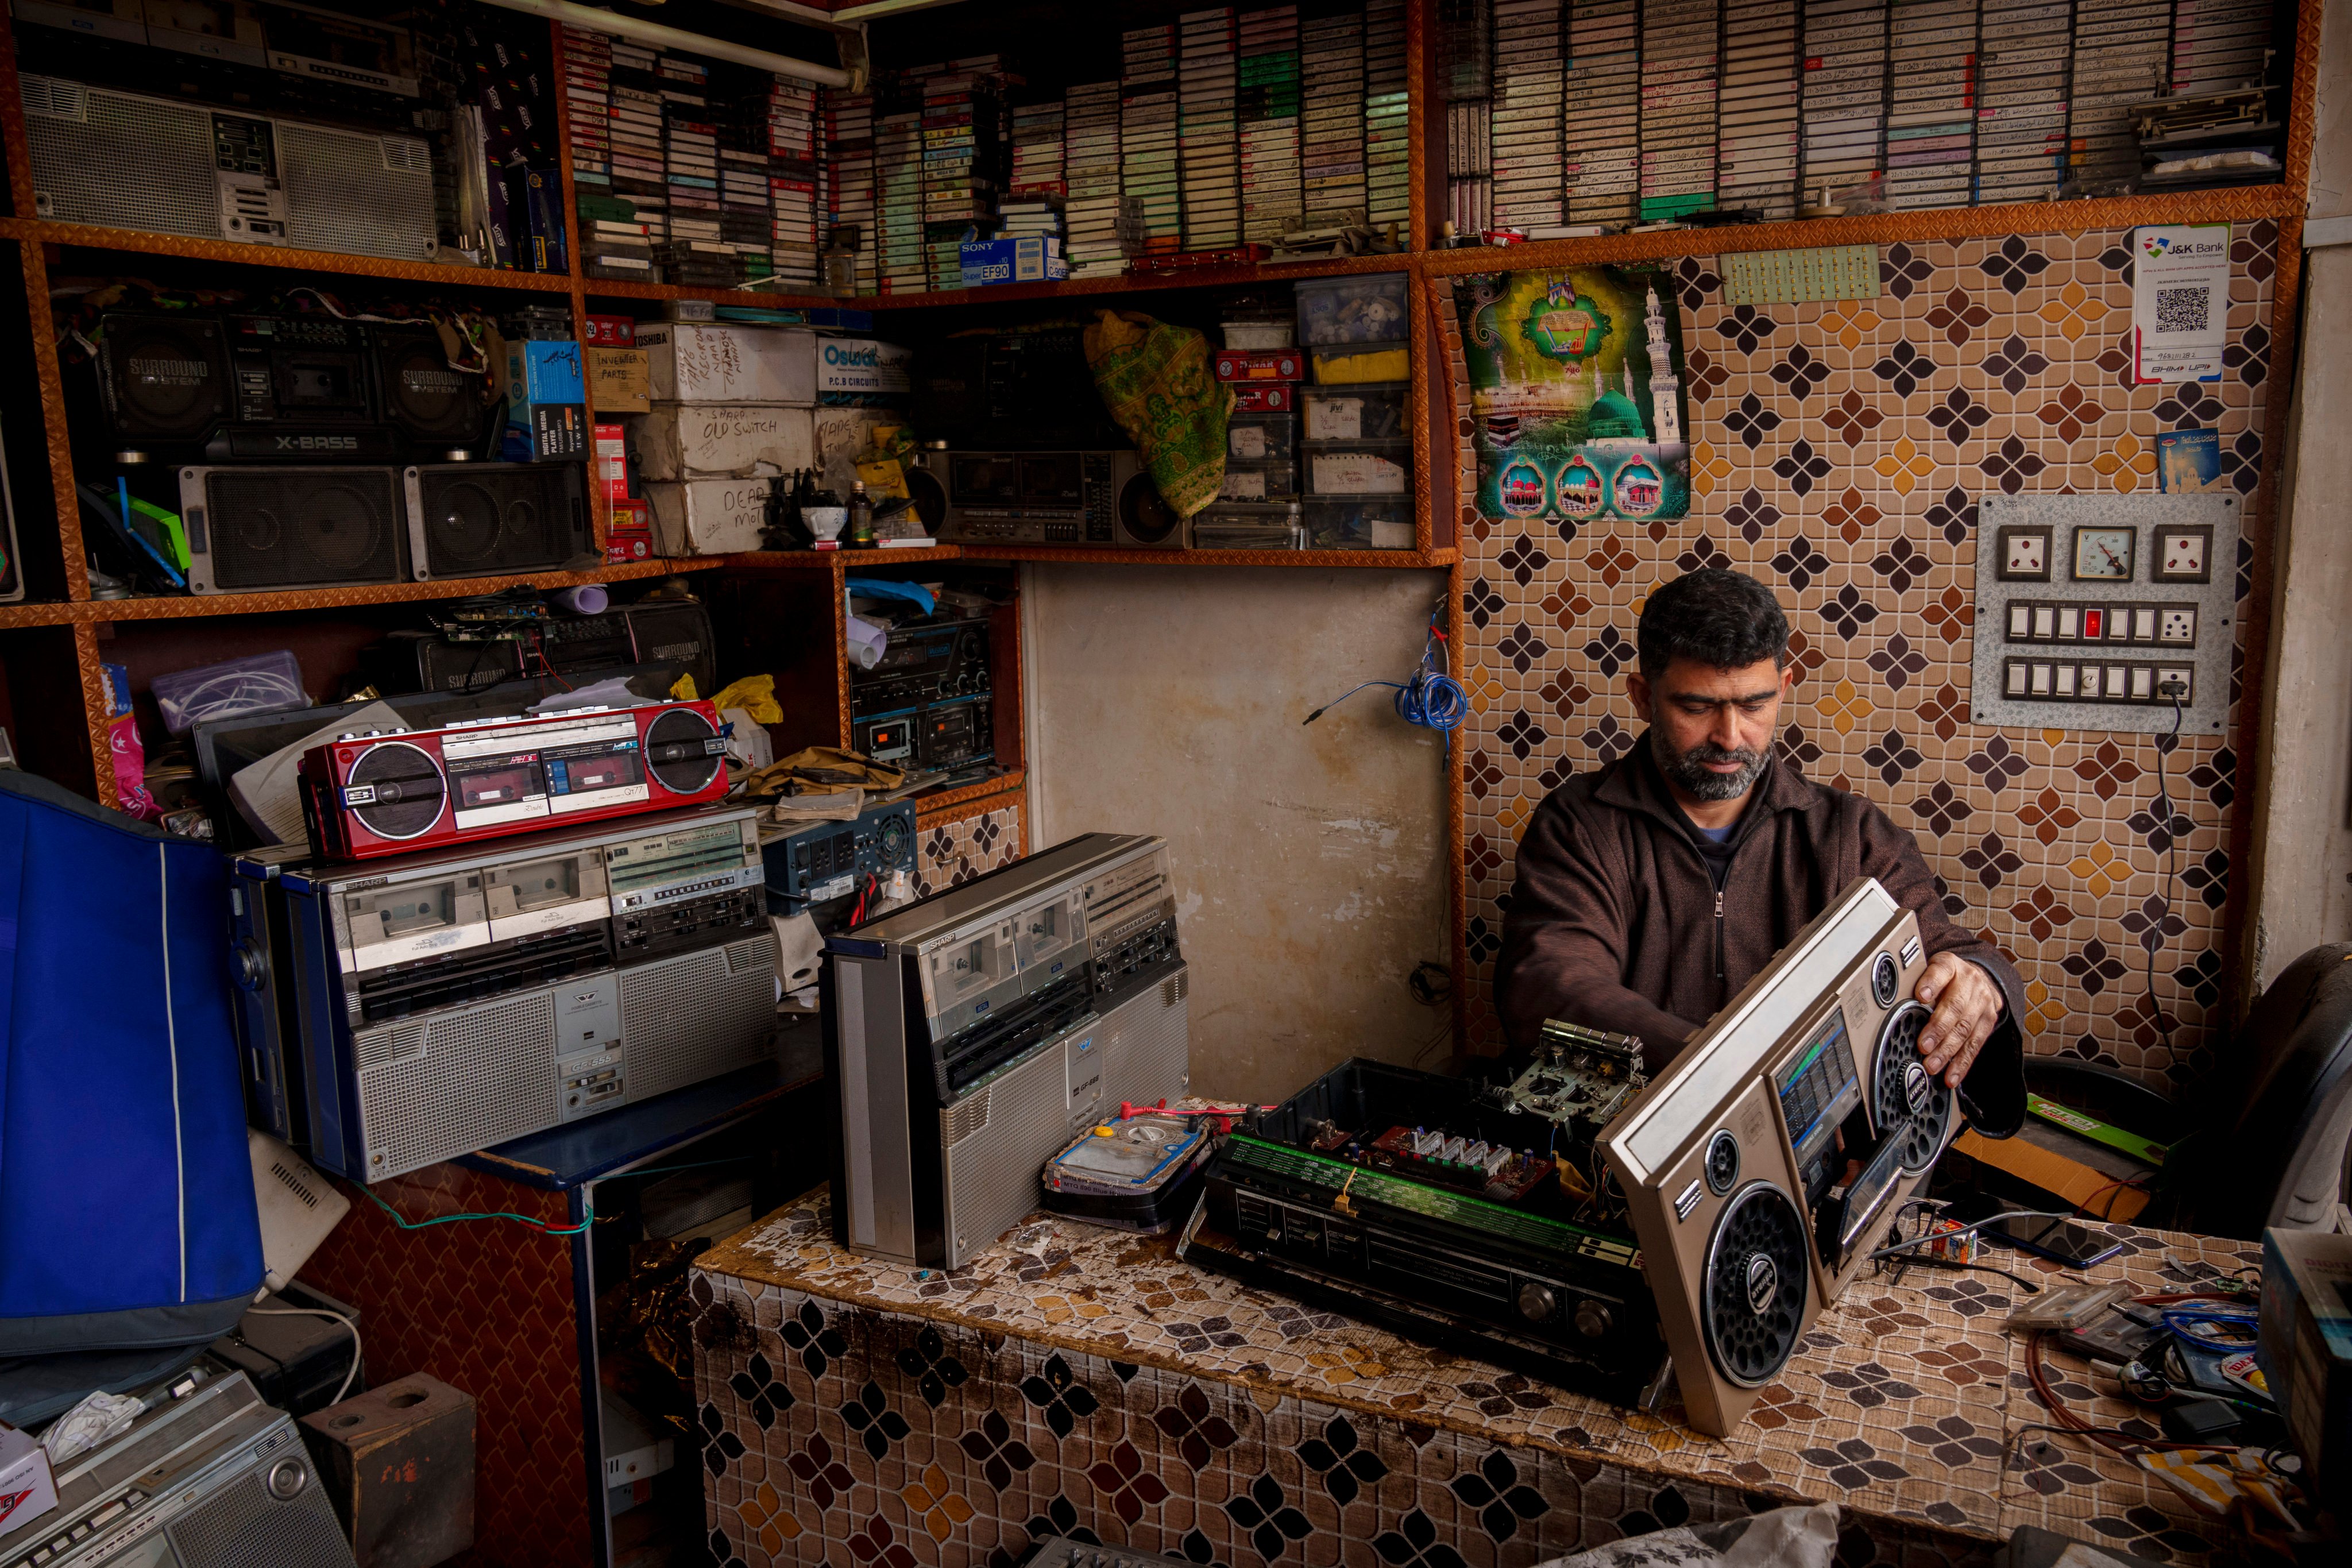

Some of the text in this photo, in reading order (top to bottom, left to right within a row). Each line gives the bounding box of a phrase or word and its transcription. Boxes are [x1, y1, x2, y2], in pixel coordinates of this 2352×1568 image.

[962, 242, 995, 252] SONY
[2168, 242, 2224, 254] J&K Bank
[963, 265, 1008, 281] Super EF90
[634, 333, 667, 347] TOSHIBA
[129, 359, 208, 377] SURROUND
[142, 375, 201, 386] SYSTEM
[829, 377, 879, 387] P.C.B CIRCUITS
[1330, 403, 1343, 412] jivi
[712, 410, 745, 421] SHARP
[704, 422, 729, 439] OLD
[276, 437, 358, 449] X-BASS
[652, 641, 700, 658] SURROUND
[524, 804, 544, 813] Double
[347, 878, 388, 890] SHARP
[930, 934, 955, 949] SHARP
[1052, 964, 1062, 972] METAL
[585, 999, 602, 1007] CASSETTE
[978, 1003, 988, 1011] METAL
[571, 1055, 612, 1072] GF-555
[1909, 1077, 1926, 1102] STEREO
[2041, 1110, 2069, 1122] SMPS
[15, 1470, 25, 1480] ISO
